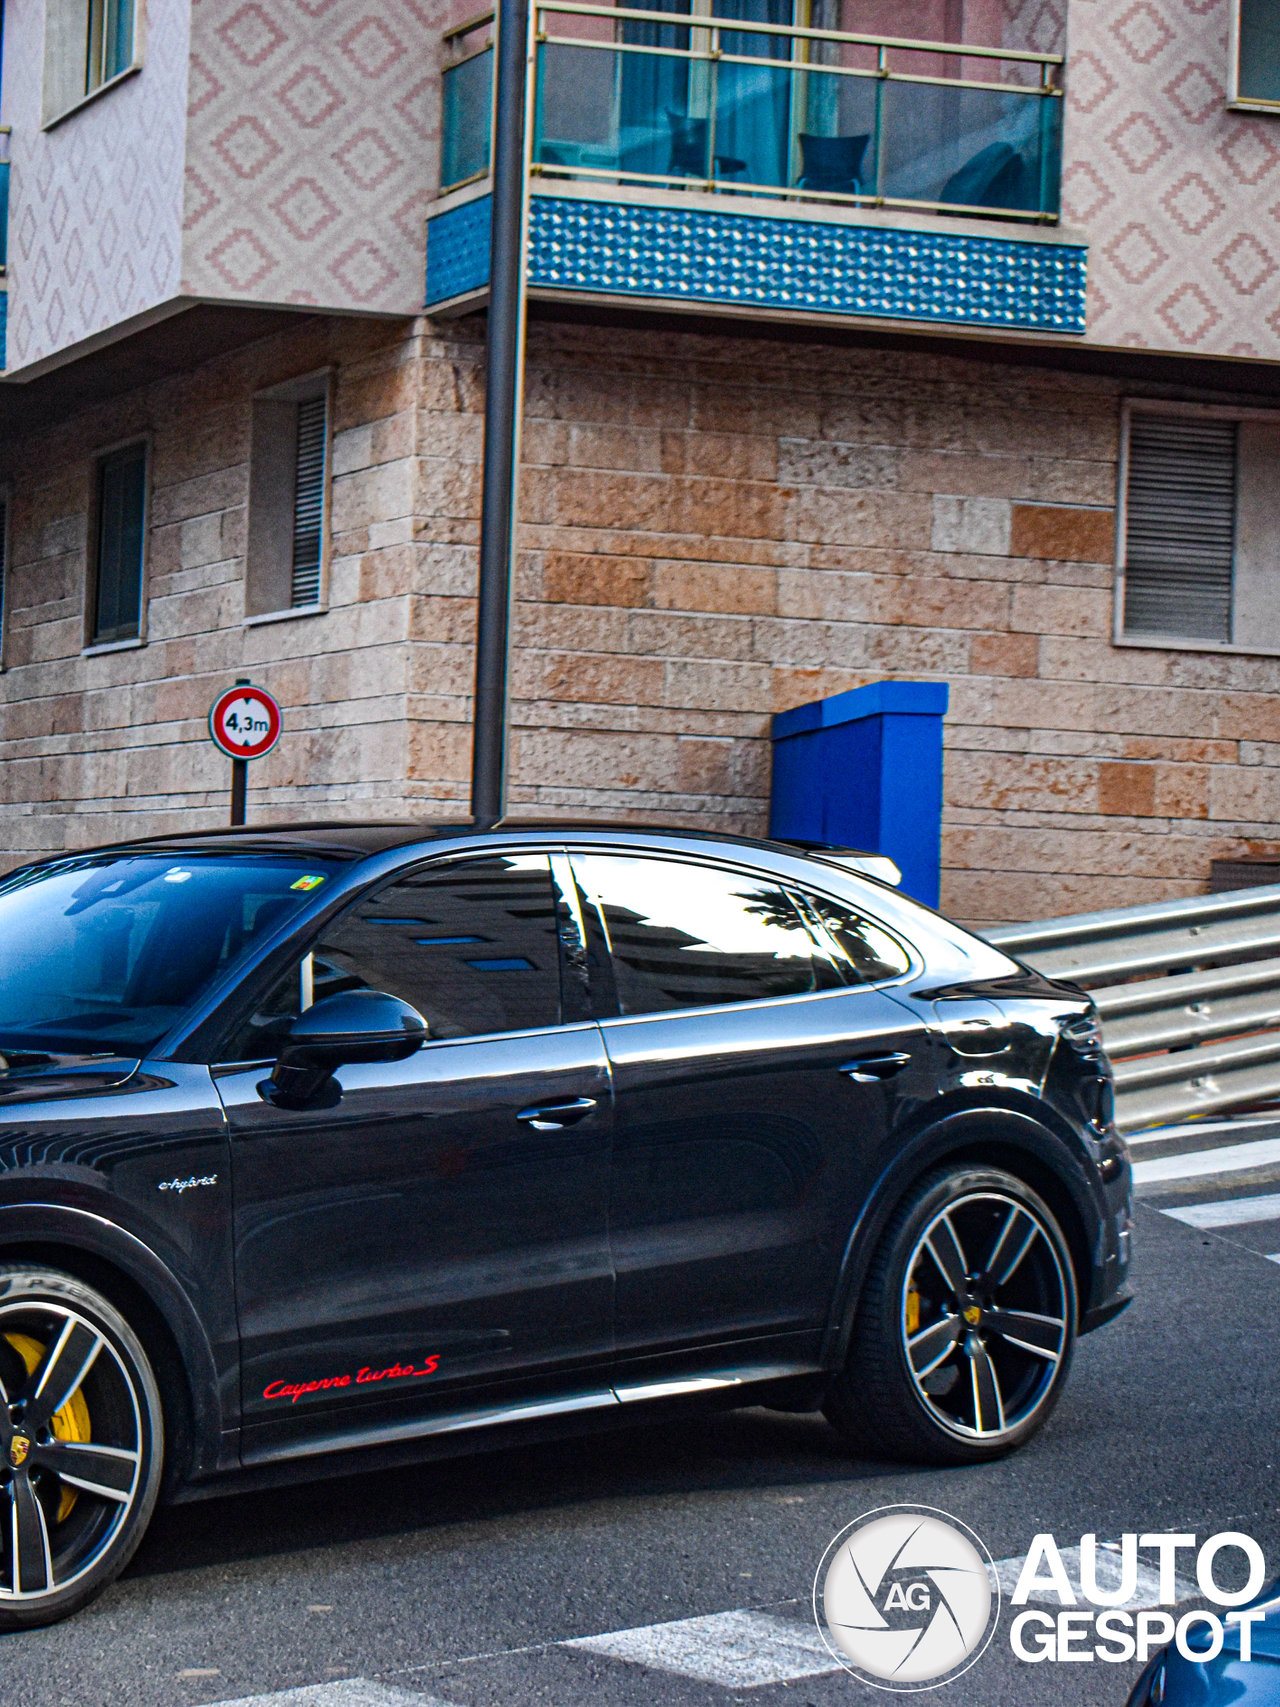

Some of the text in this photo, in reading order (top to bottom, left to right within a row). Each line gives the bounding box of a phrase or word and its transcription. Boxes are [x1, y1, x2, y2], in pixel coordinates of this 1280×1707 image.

[225, 713, 269, 733] 4,3m
[158, 1174, 218, 1193] e-hybrid
[263, 1380, 351, 1403] Cayenne
[412, 1354, 441, 1376] S
